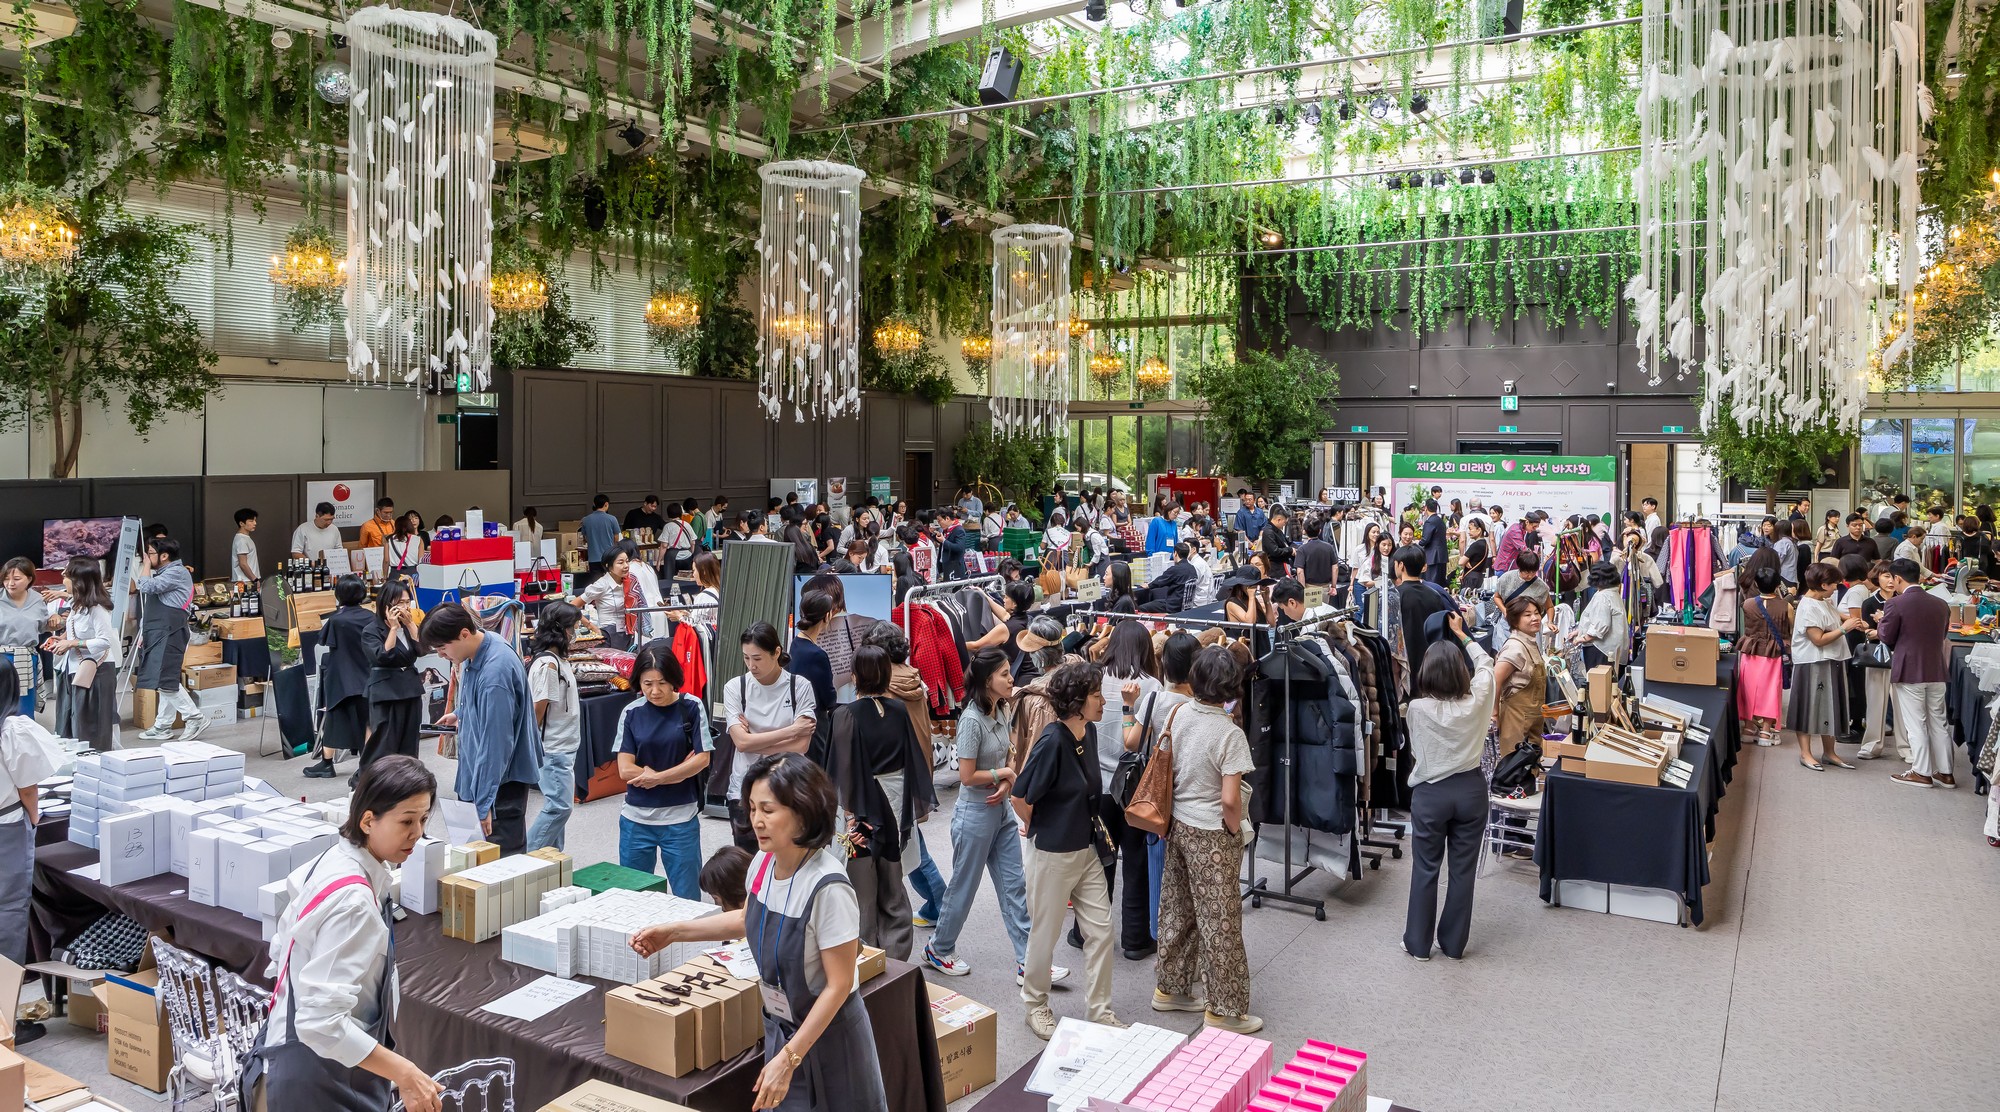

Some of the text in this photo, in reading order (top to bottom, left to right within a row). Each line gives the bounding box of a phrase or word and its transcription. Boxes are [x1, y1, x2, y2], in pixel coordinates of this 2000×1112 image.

[1416, 461, 1591, 477] 제24회 미래회 자선 바자회
[1328, 489, 1359, 500] FURY
[334, 503, 355, 511] omato
[916, 551, 925, 560] 20
[127, 827, 143, 842] 13
[177, 824, 186, 841] 17
[225, 859, 236, 880] 19
[947, 1045, 973, 1063] 발효식품
